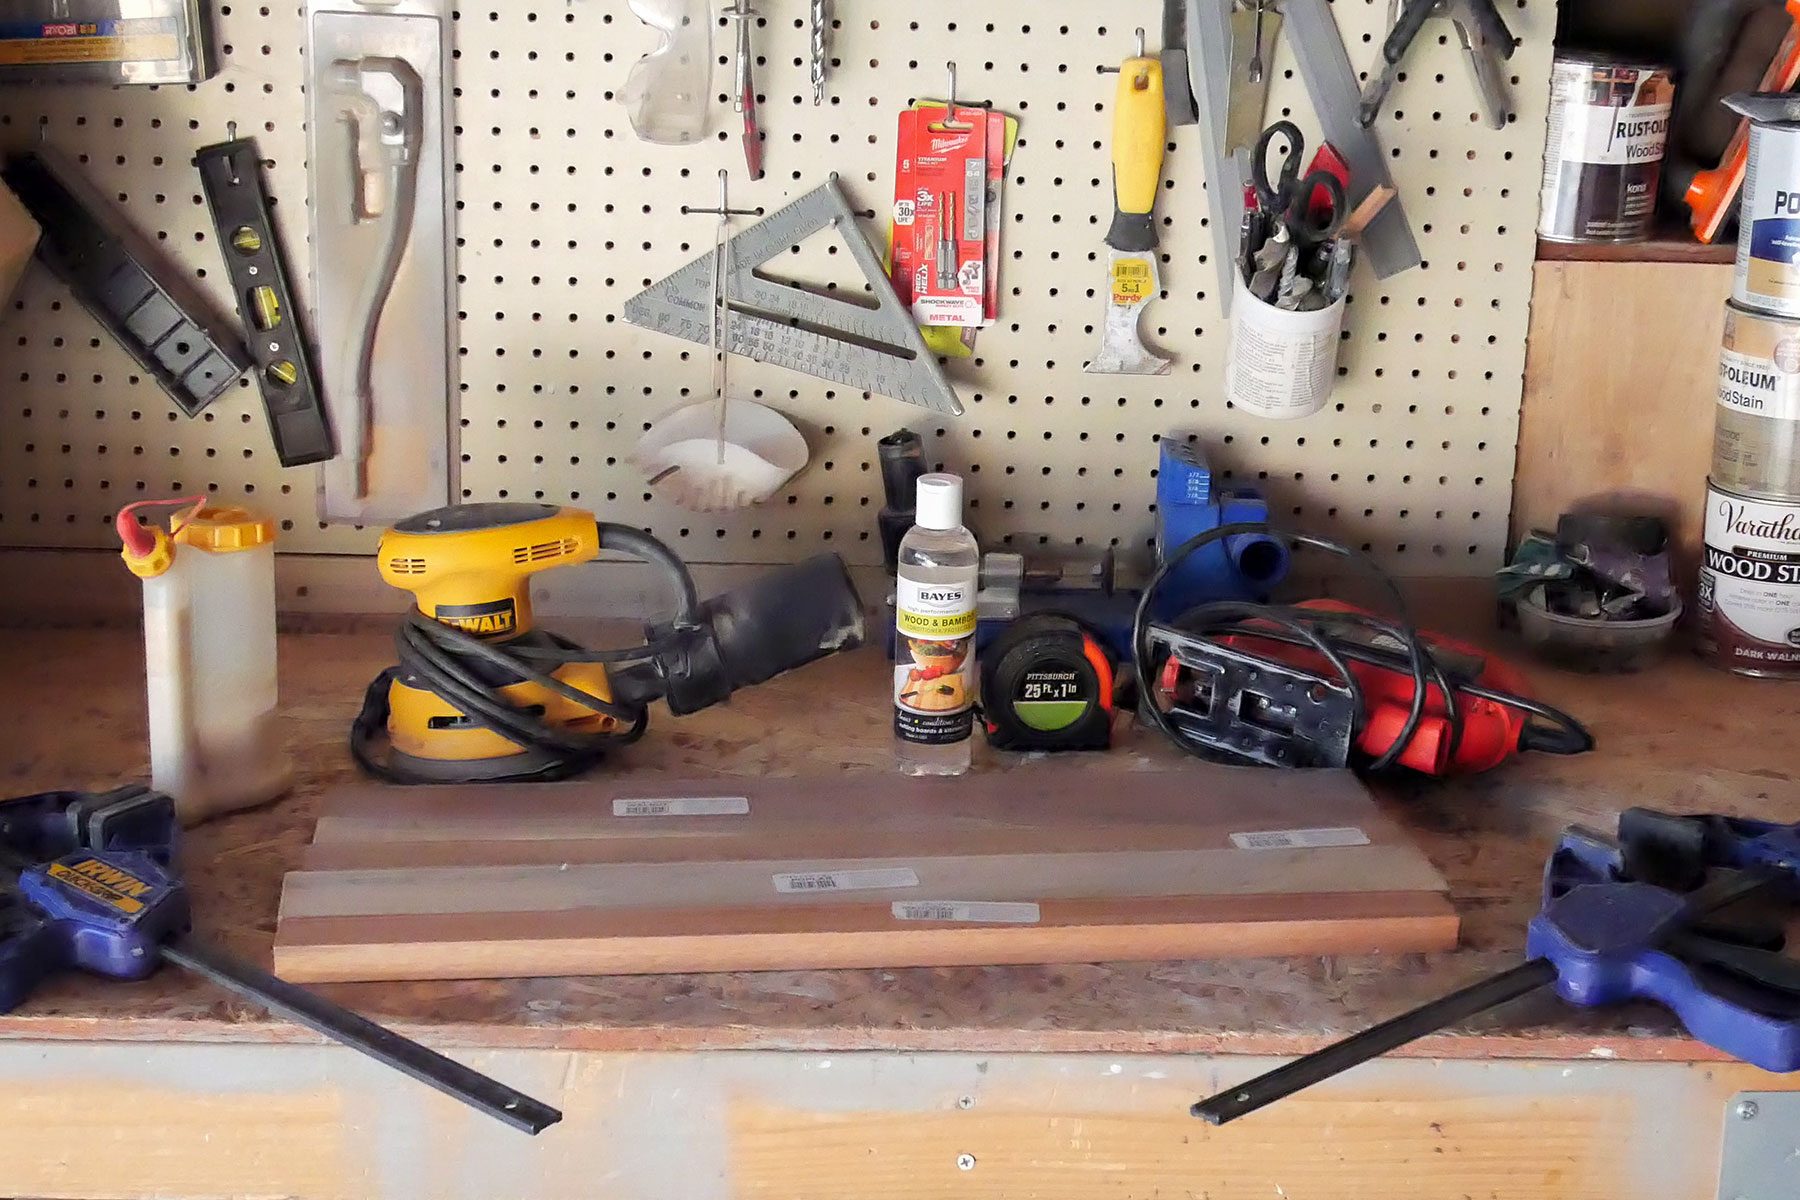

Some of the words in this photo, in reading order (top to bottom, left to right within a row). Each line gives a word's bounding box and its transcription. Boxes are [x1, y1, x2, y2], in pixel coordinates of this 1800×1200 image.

[667, 295, 706, 311] COMMON
[1113, 293, 1142, 303] Purdy
[1746, 550, 1788, 561] PREMIUM
[1709, 549, 1772, 580] WOOD
[1776, 564, 1800, 582] ST
[921, 591, 961, 601] BAYES
[904, 614, 930, 626] WOOD
[932, 619, 938, 627] &
[1735, 647, 1764, 659] DARK
[1767, 651, 1800, 662] WALN
[1024, 683, 1041, 699] 25
[1061, 683, 1067, 698] 1
[72, 859, 153, 897] IRWIN
